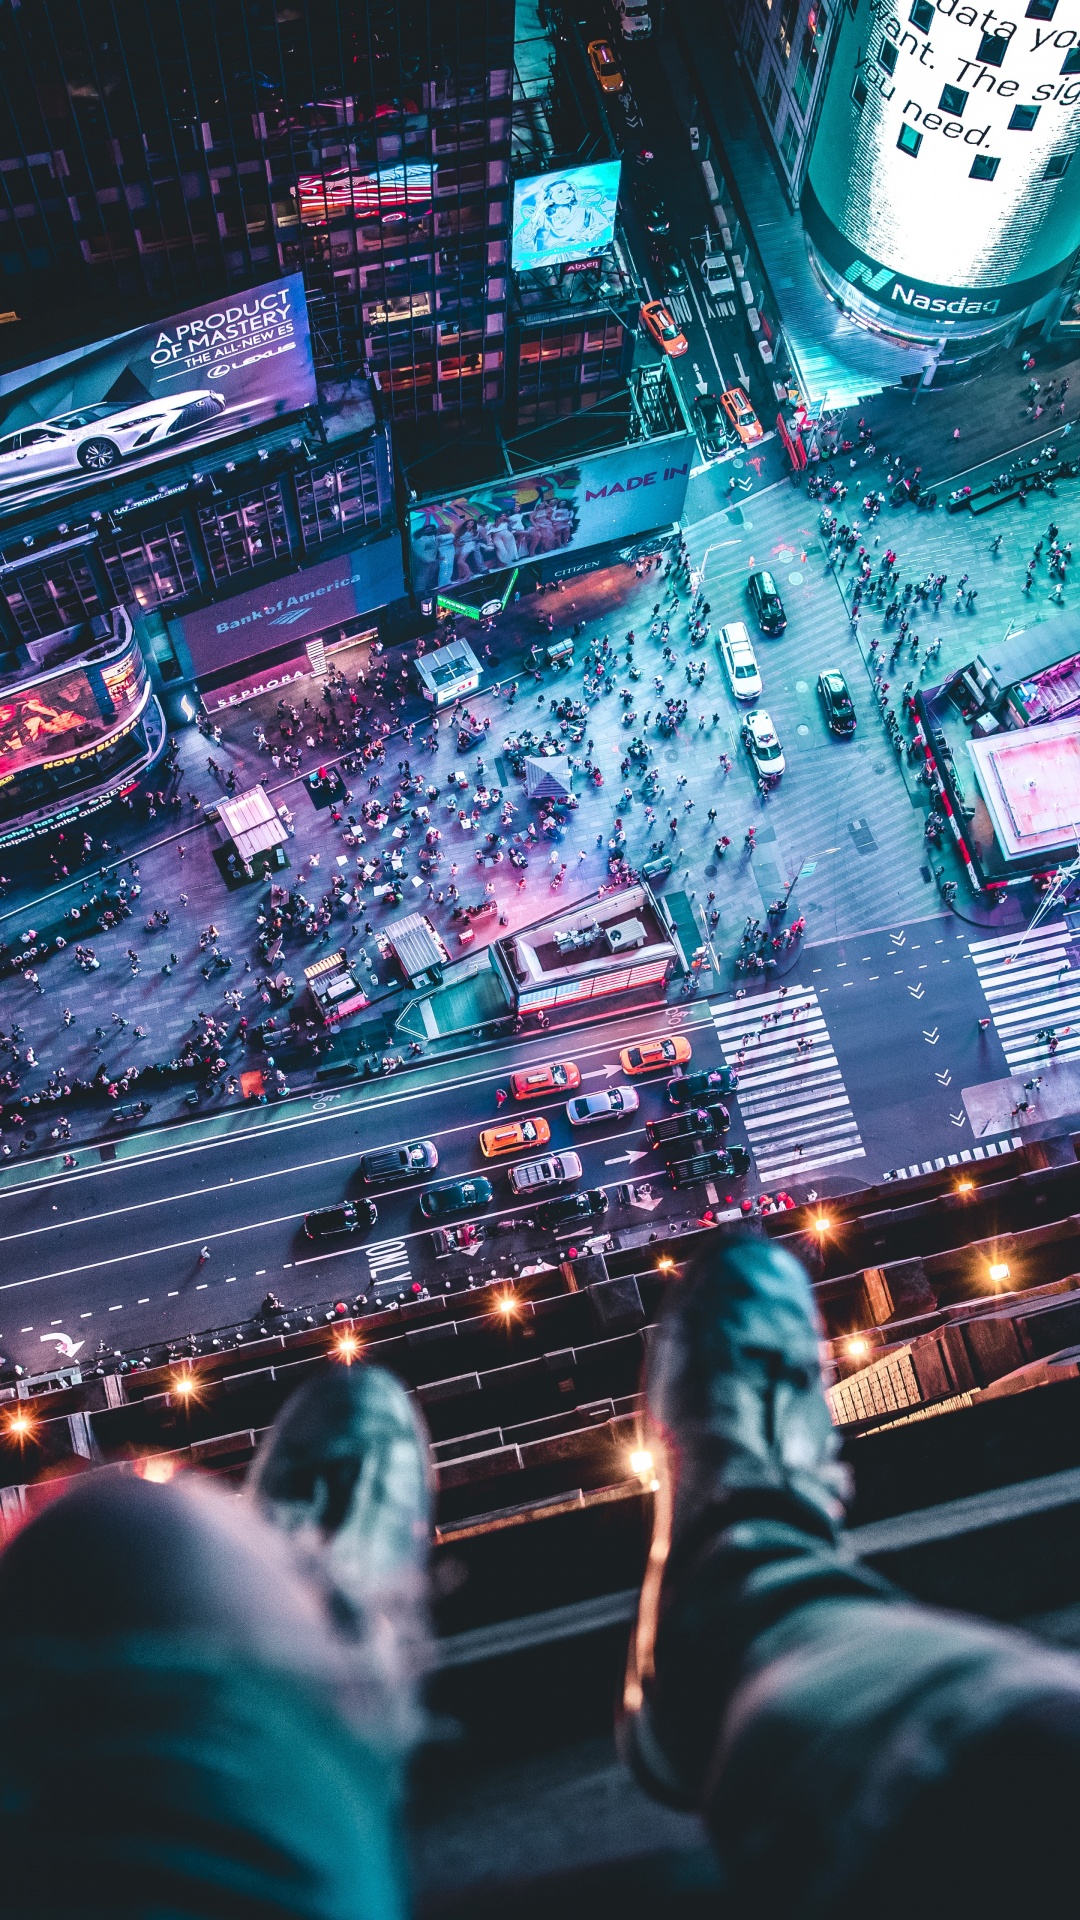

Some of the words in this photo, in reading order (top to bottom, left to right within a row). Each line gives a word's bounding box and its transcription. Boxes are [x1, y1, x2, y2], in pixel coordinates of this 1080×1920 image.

[936, 0, 1018, 40] data
[1029, 28, 1080, 52] yo
[956, 57, 1020, 97] The
[854, 46, 896, 101] you
[902, 99, 992, 148] need.
[566, 261, 599, 272] Absen
[156, 332, 173, 348] A
[176, 288, 290, 341] PRODUCT
[659, 294, 693, 324] ONL
[890, 283, 1001, 315] Nasdaq
[150, 342, 183, 364] OF
[188, 304, 291, 353] MASTERY
[185, 352, 212, 368] THE
[214, 330, 274, 359] ALL-NEW
[278, 323, 294, 336] ES
[232, 341, 297, 370] LEXUS
[585, 471, 658, 502] MADE
[663, 463, 689, 481] IN
[554, 560, 600, 577] CITIZEN
[215, 611, 263, 634] Bank
[265, 600, 283, 615] of
[286, 574, 361, 608] America
[217, 670, 304, 708] SEPHORA
[43, 755, 77, 770] NOW
[79, 749, 96, 761] ON
[98, 777, 136, 802] NEWS
[56, 806, 80, 820] died
[365, 1241, 412, 1286] ONLY
